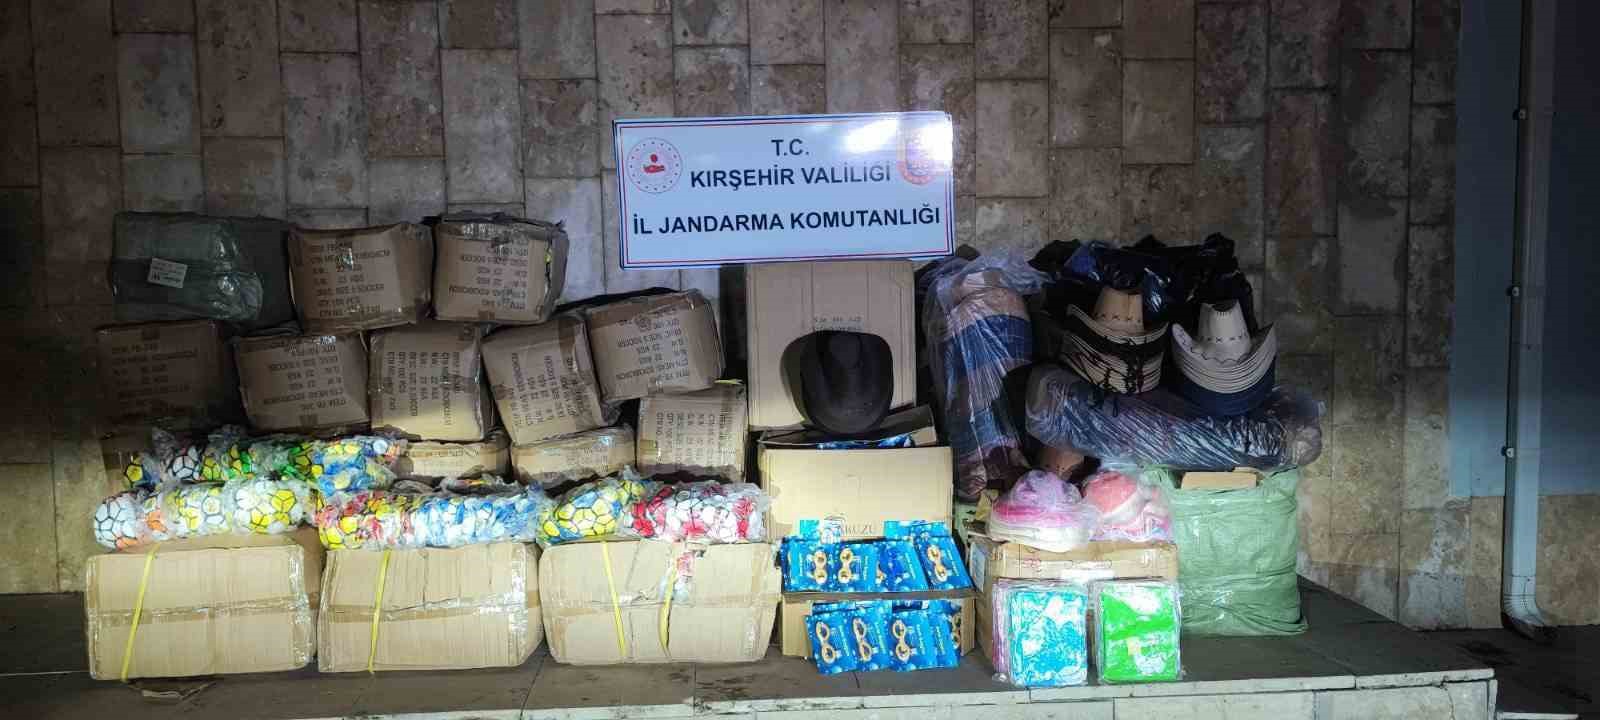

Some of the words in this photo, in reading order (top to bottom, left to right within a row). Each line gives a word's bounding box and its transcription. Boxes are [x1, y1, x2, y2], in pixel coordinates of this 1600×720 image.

[771, 139, 809, 157] T.C.
[691, 164, 794, 191] KIRŞEHİR
[805, 161, 890, 183] VALİLİĞİ
[633, 213, 652, 235] İL
[659, 211, 784, 234] JANDARMA
[790, 203, 940, 229] KOMUTANLIĞI
